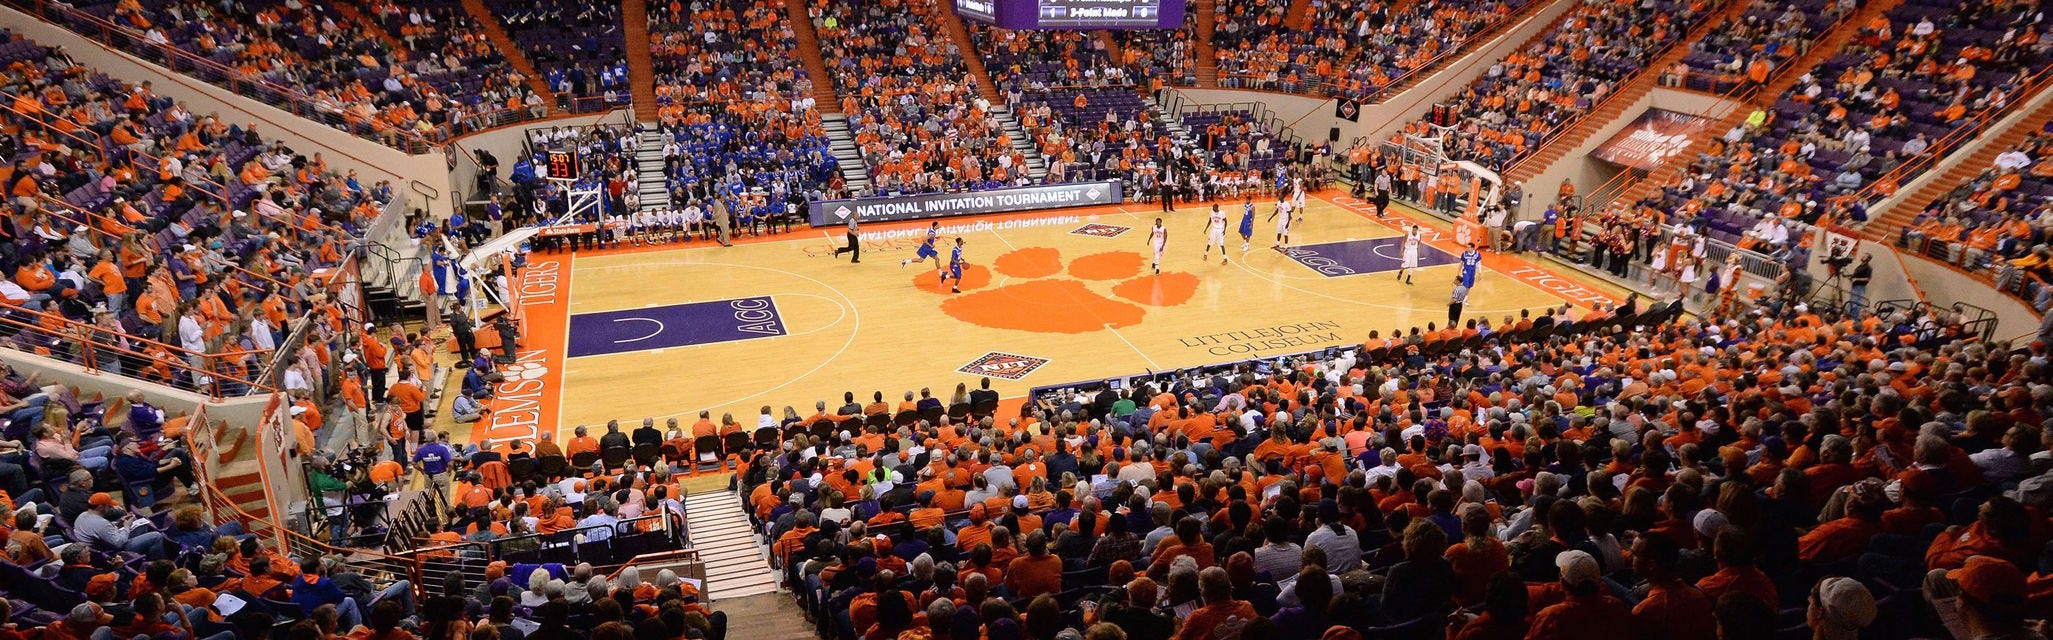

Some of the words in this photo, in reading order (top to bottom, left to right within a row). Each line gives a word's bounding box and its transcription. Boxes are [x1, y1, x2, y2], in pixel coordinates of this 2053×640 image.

[1069, 7, 1102, 17] 3-Point
[1103, 7, 1128, 17] Made
[551, 162, 568, 177] 33
[856, 201, 922, 217] NATIONAL
[924, 192, 994, 213] INVITATION
[996, 189, 1081, 207] TOURNAMENT
[519, 260, 560, 306] TIGERS
[1511, 265, 1622, 310] TIGER
[730, 299, 780, 335] ACC
[1177, 320, 1343, 348] LITTLEJOHN
[1208, 332, 1343, 356] COLISEUM
